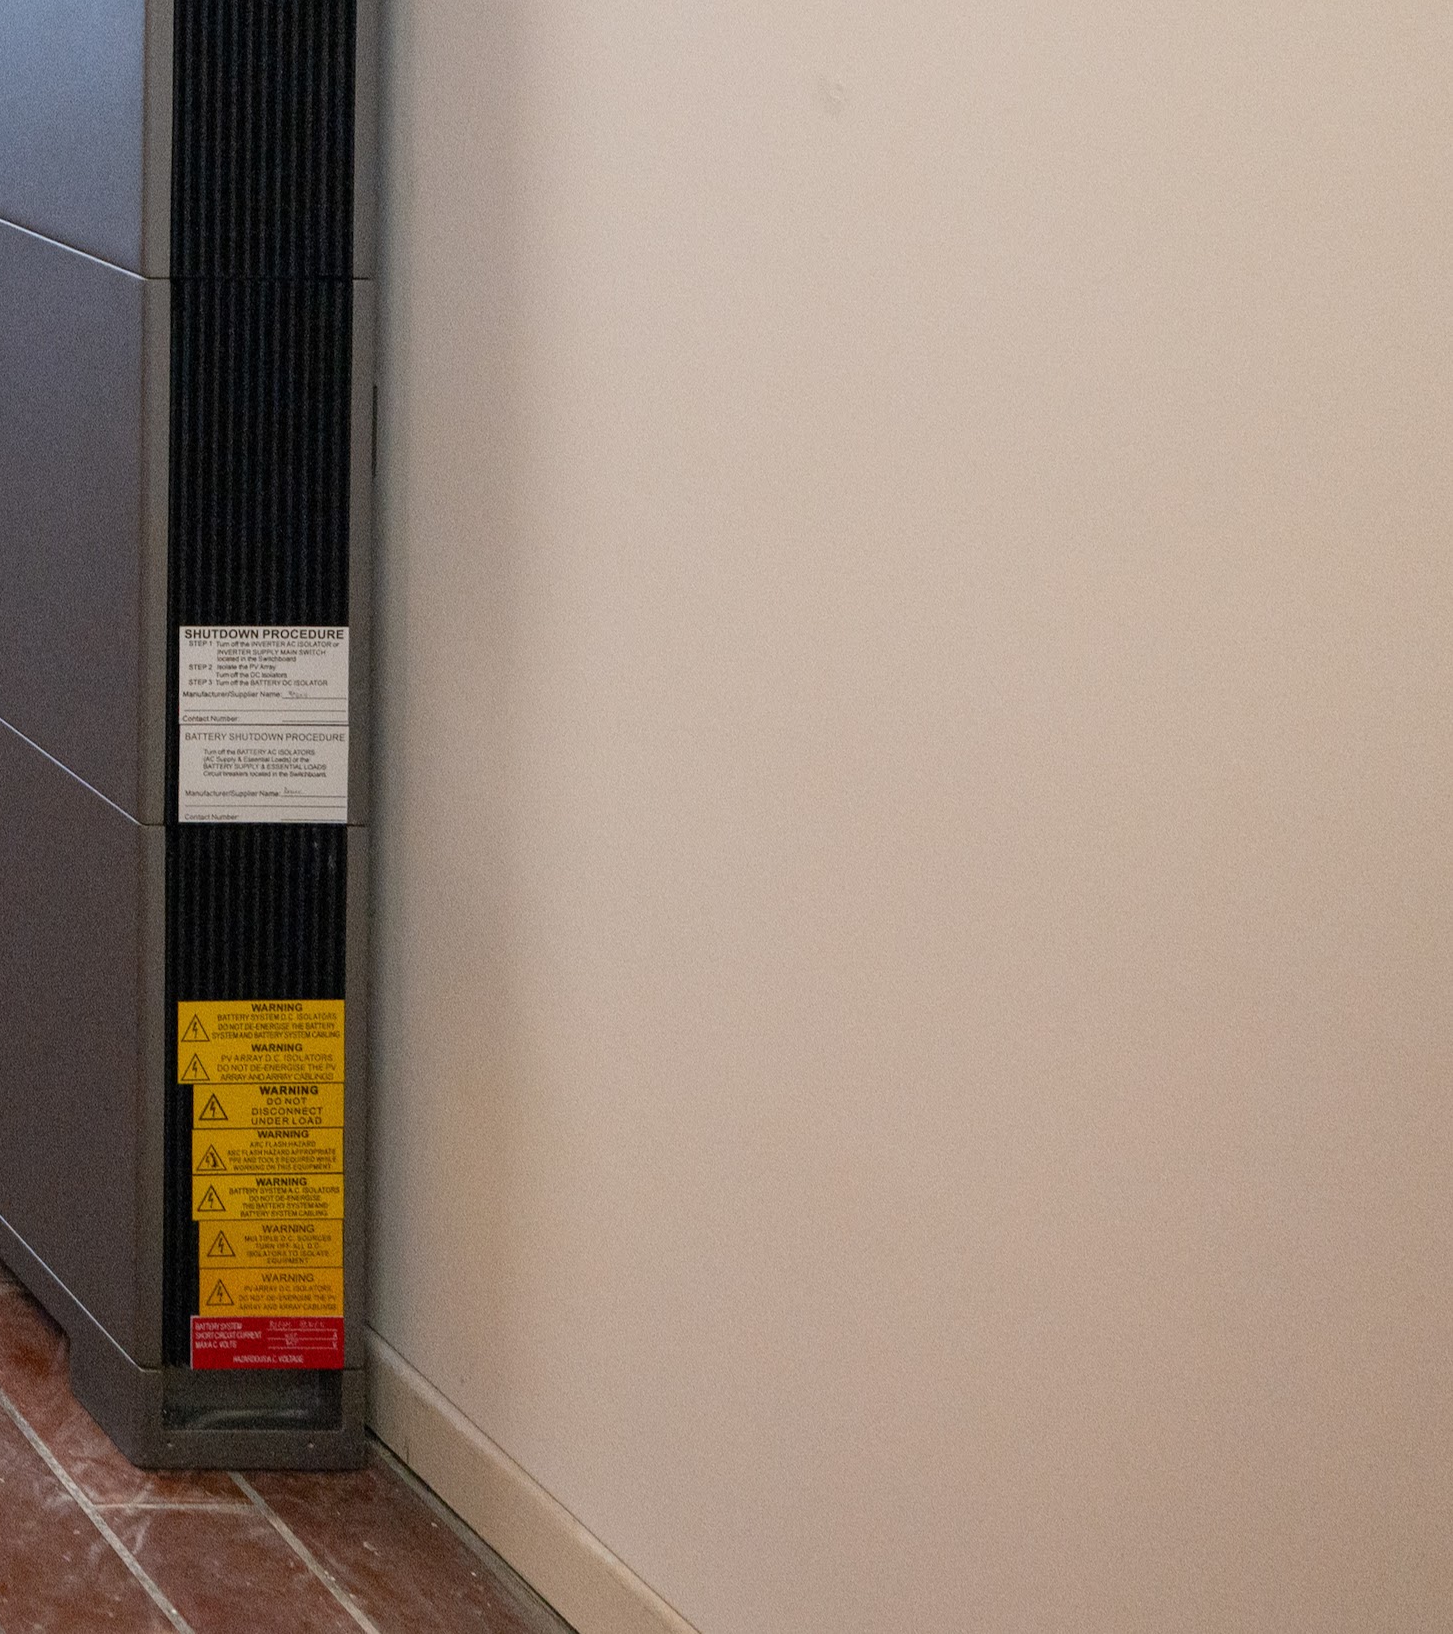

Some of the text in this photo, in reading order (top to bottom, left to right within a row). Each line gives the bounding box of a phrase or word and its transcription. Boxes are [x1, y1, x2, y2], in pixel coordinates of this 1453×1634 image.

[185, 629, 345, 639] SHUTDOWN PROCEDURE
[185, 733, 345, 741] BATTERY SHUTDOWN PROCEDURE
[251, 1004, 303, 1012] WARNING
[251, 1043, 303, 1052] WARNING
[259, 1085, 319, 1095] WARNING
[266, 1097, 307, 1105] DO NOT
[251, 1107, 323, 1116] DISCONNECT
[251, 1117, 323, 1125] UNDER LOAD
[257, 1130, 310, 1138] WARNING
[255, 1177, 308, 1186] WARNING
[262, 1225, 314, 1233] WARNING
[262, 1274, 314, 1282] WARNING
